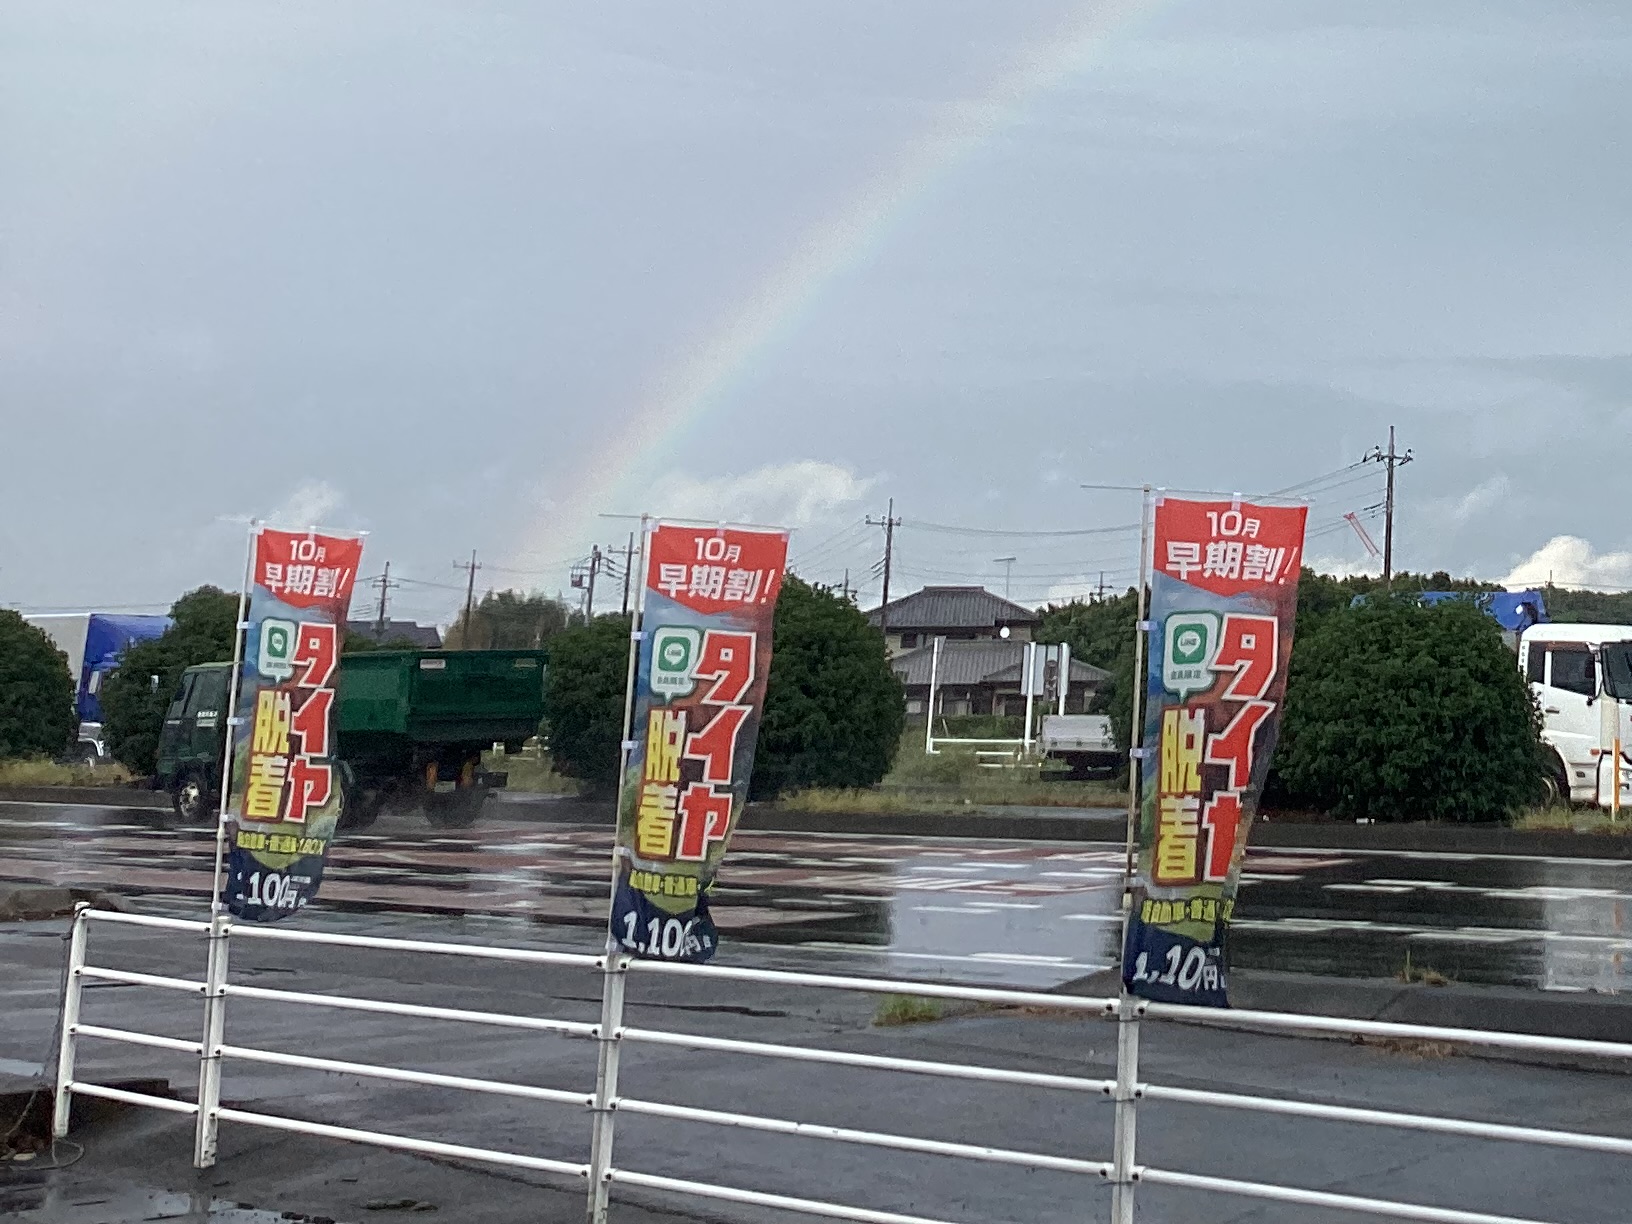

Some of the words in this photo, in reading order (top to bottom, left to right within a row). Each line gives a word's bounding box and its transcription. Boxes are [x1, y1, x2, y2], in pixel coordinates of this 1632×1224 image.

[290, 540, 326, 563] 10月
[694, 537, 741, 564] 10月
[1206, 510, 1261, 539] 10月
[283, 621, 336, 823] タイヤ
[638, 709, 687, 856] 脱着
[676, 628, 757, 862] タイヤ
[1158, 709, 1206, 879] 脱着
